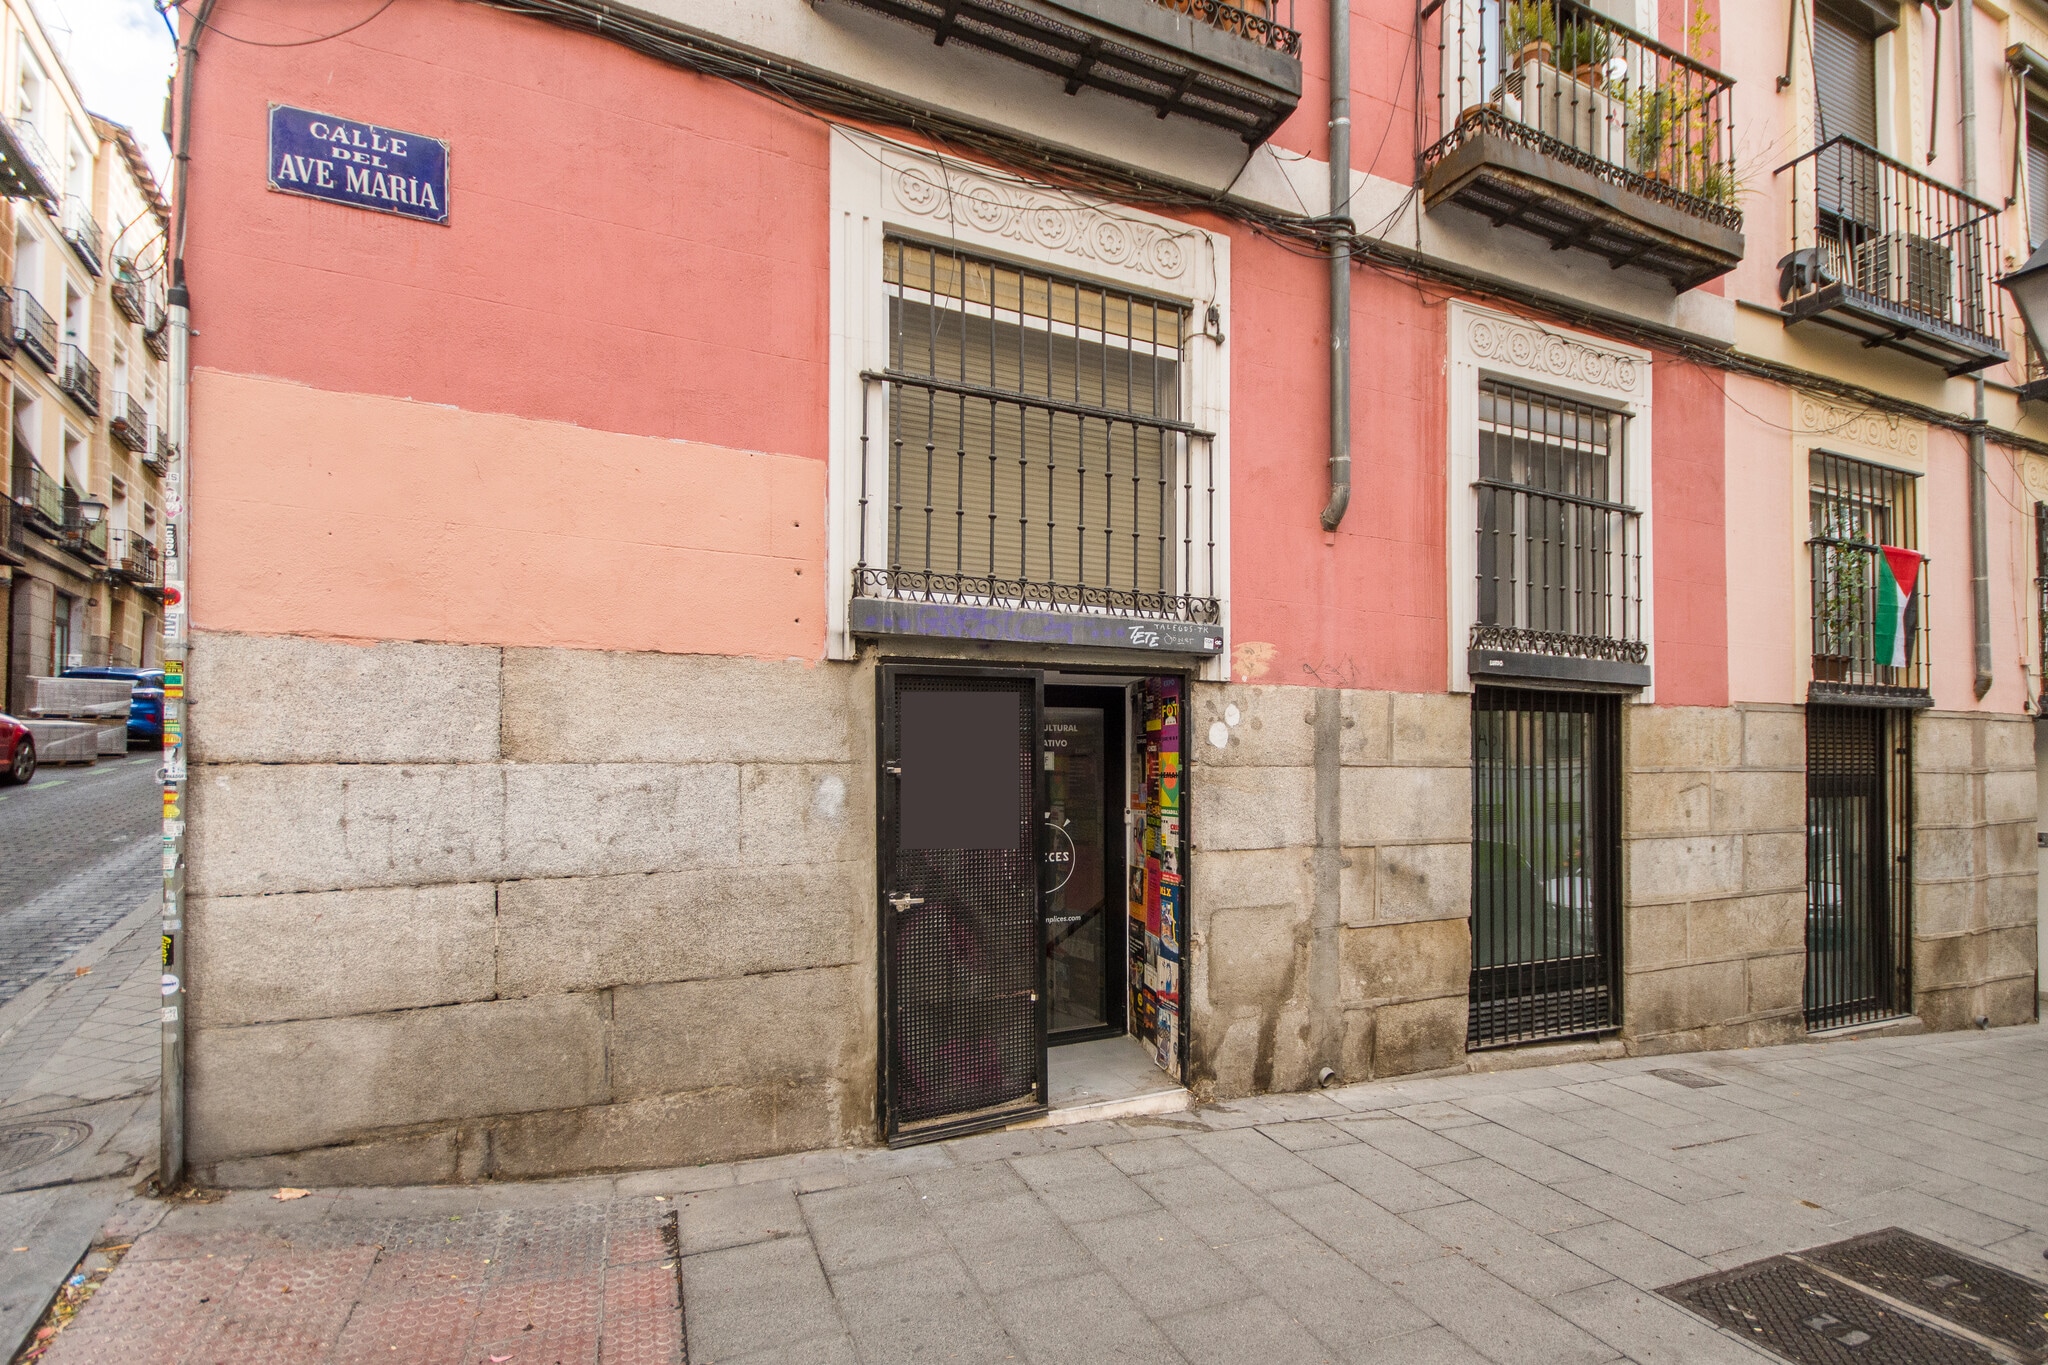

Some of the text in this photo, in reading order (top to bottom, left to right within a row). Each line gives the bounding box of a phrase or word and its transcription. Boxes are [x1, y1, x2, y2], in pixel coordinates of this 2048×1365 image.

[310, 121, 408, 157] CALLE
[332, 147, 388, 169] DEL
[278, 153, 334, 189] AVE
[1128, 625, 1160, 647] TETE
[1045, 851, 1069, 862] CES
